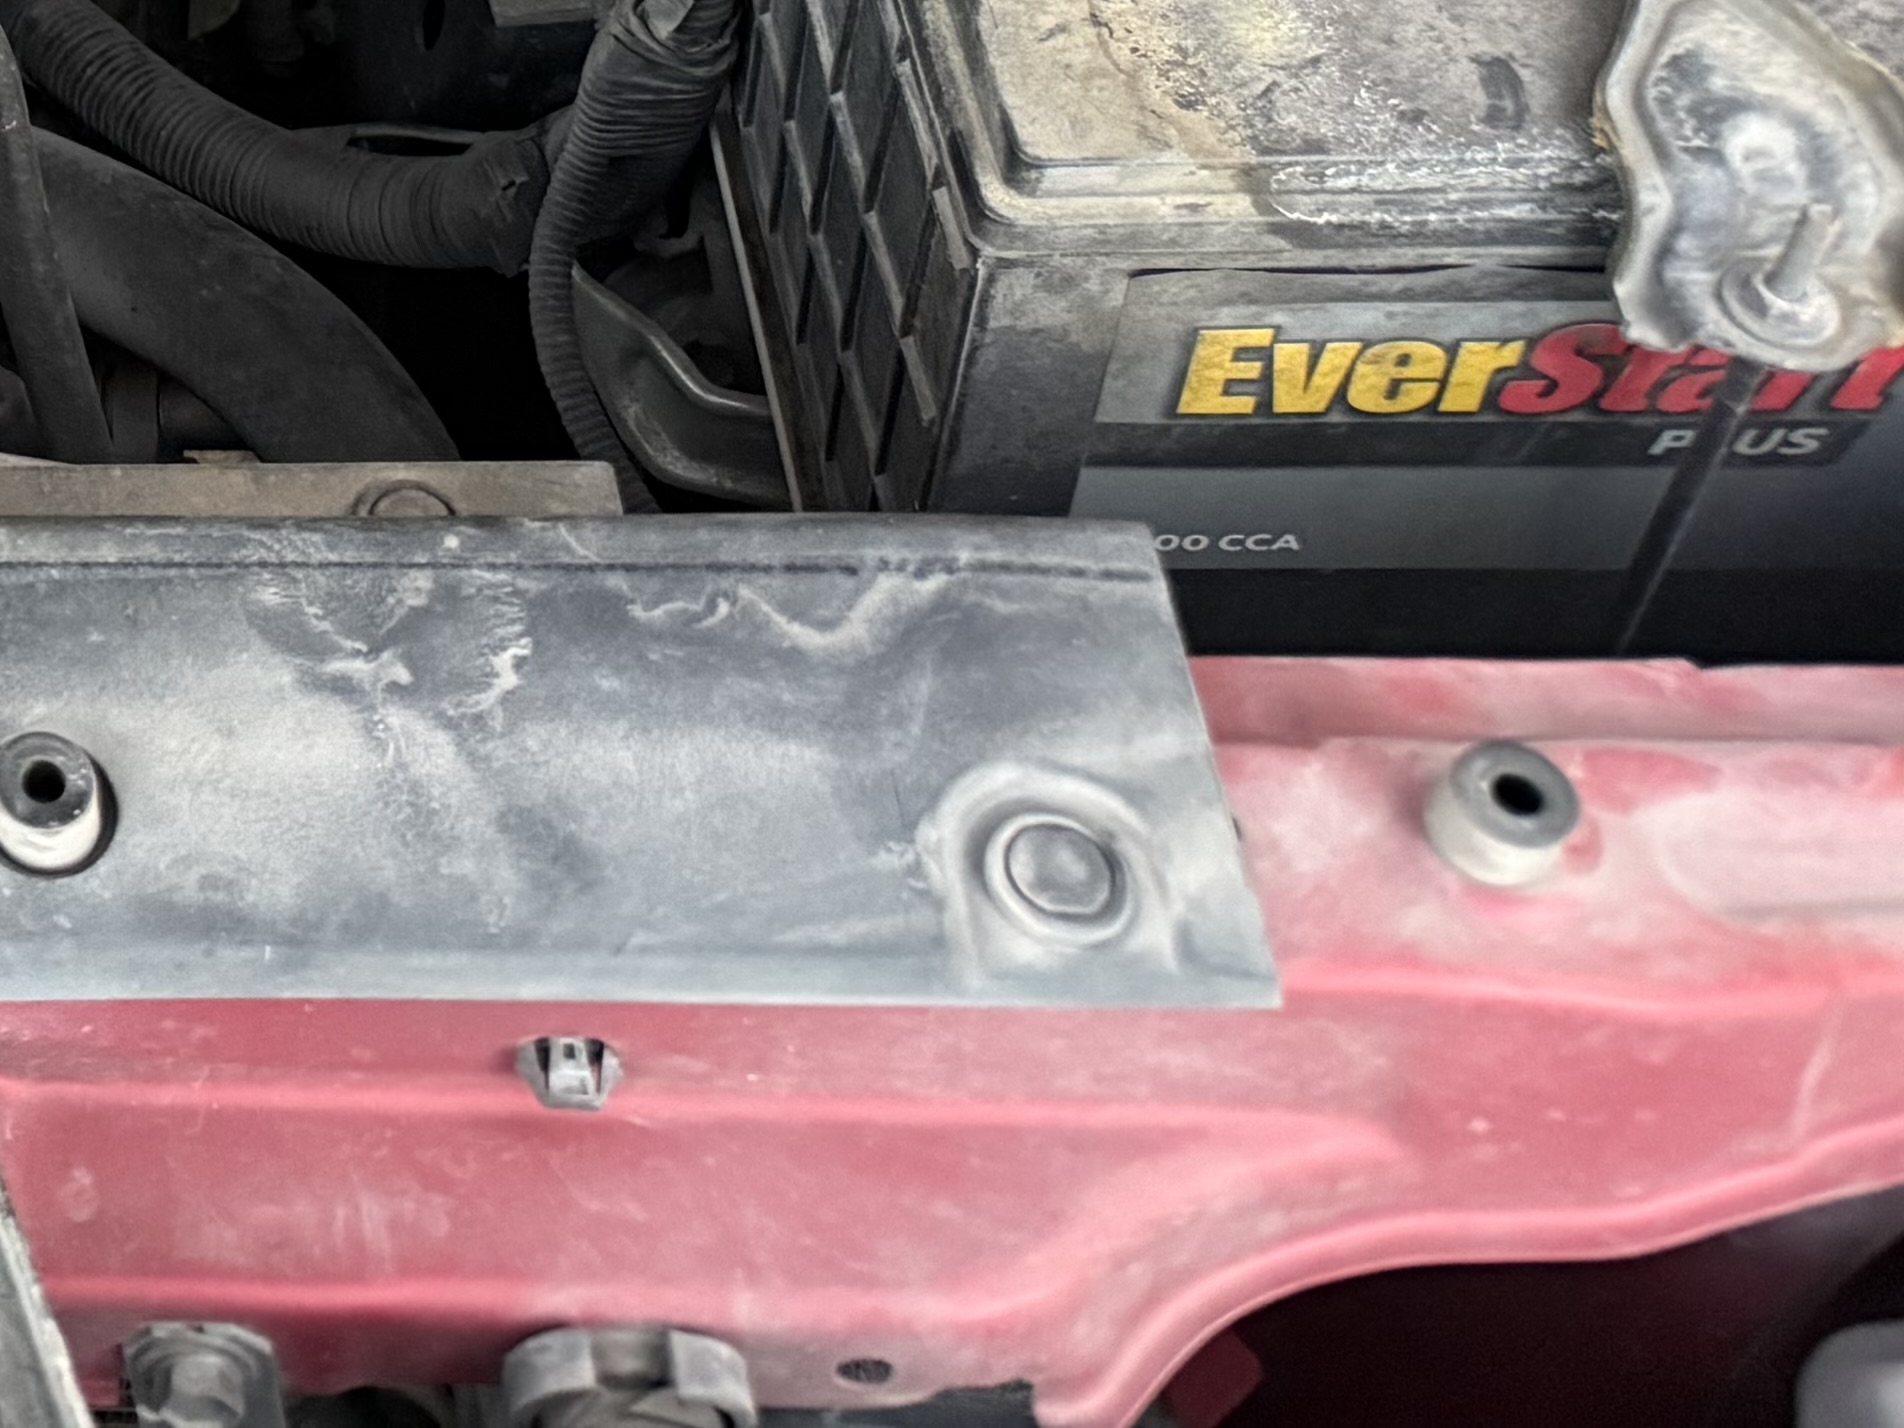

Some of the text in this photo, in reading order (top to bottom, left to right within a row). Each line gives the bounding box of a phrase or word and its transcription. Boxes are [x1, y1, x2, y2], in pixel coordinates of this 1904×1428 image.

[1647, 427, 1830, 456] PUS
[1153, 533, 1300, 552] 00 CCA
